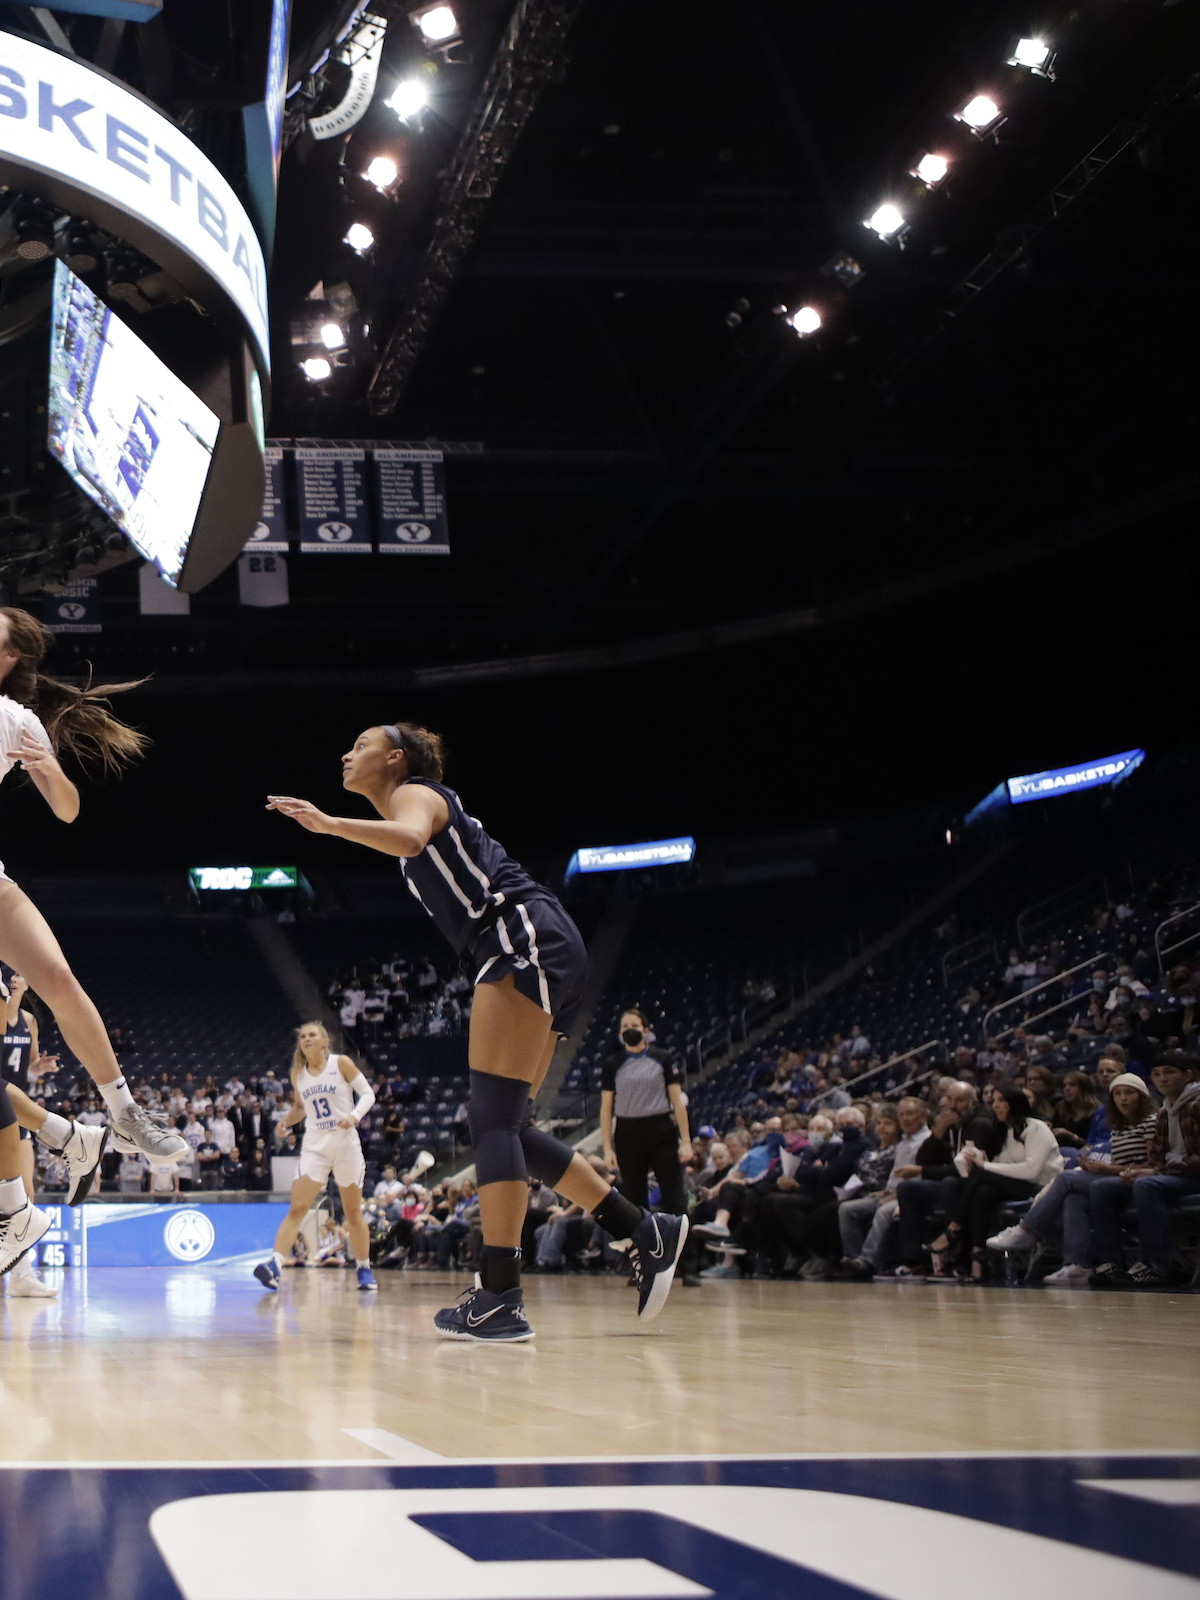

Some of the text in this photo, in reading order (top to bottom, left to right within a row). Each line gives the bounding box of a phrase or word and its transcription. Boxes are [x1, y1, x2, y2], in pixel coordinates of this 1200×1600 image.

[249, 556, 277, 573] 22
[1011, 759, 1131, 797] BYUBASKETBA
[8, 1047, 22, 1073] 4
[302, 1085, 336, 1100] BRIGHAM
[313, 1098, 332, 1119] 13
[44, 1206, 62, 1229] 21
[43, 1244, 65, 1267] 45
